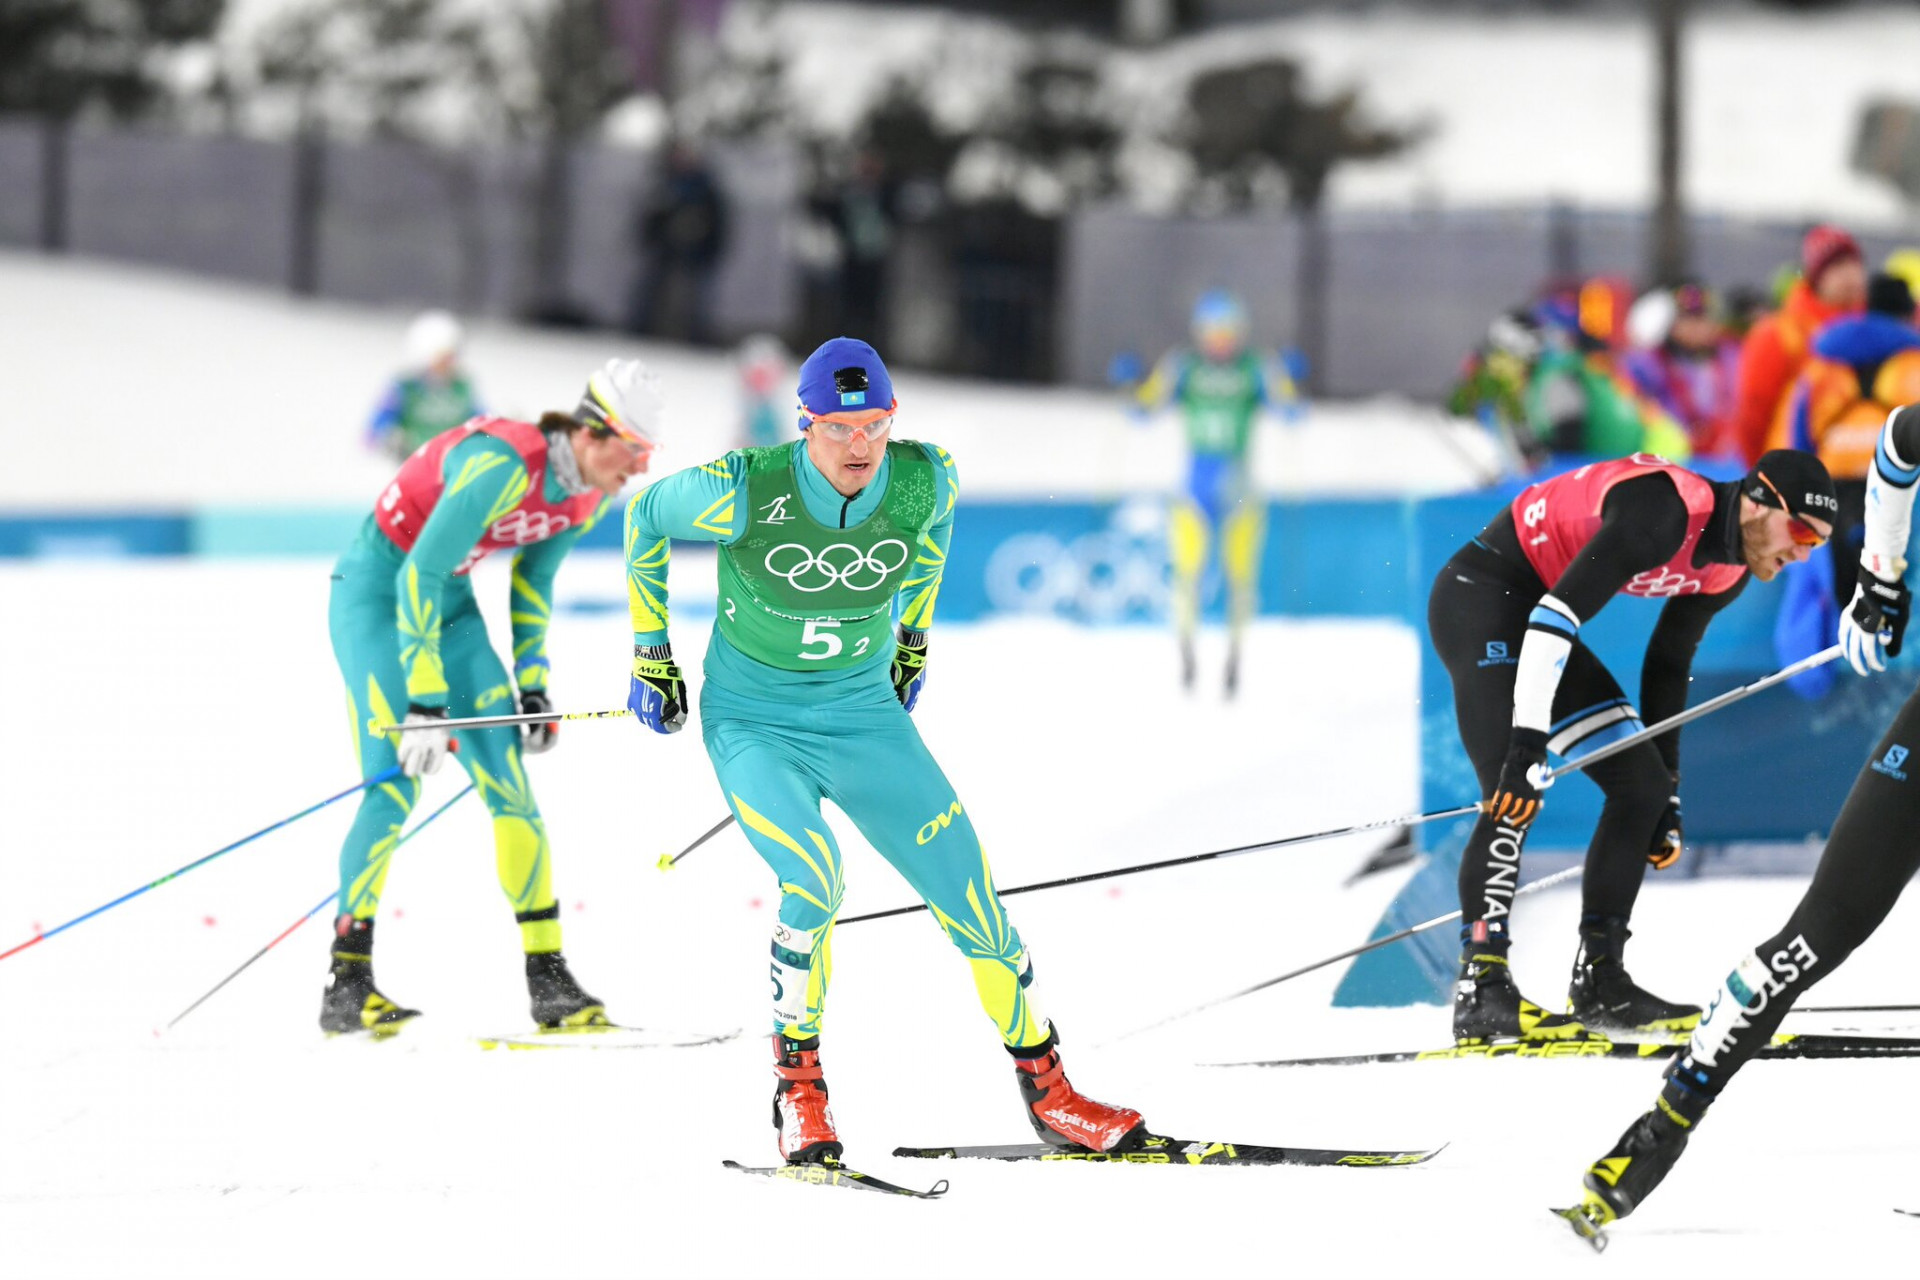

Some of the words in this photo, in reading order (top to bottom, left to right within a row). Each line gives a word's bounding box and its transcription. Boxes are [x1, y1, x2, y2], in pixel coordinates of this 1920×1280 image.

[724, 597, 736, 622] 2
[797, 620, 843, 660] 5
[851, 636, 870, 657] 2
[1044, 1108, 1098, 1133] alpina
